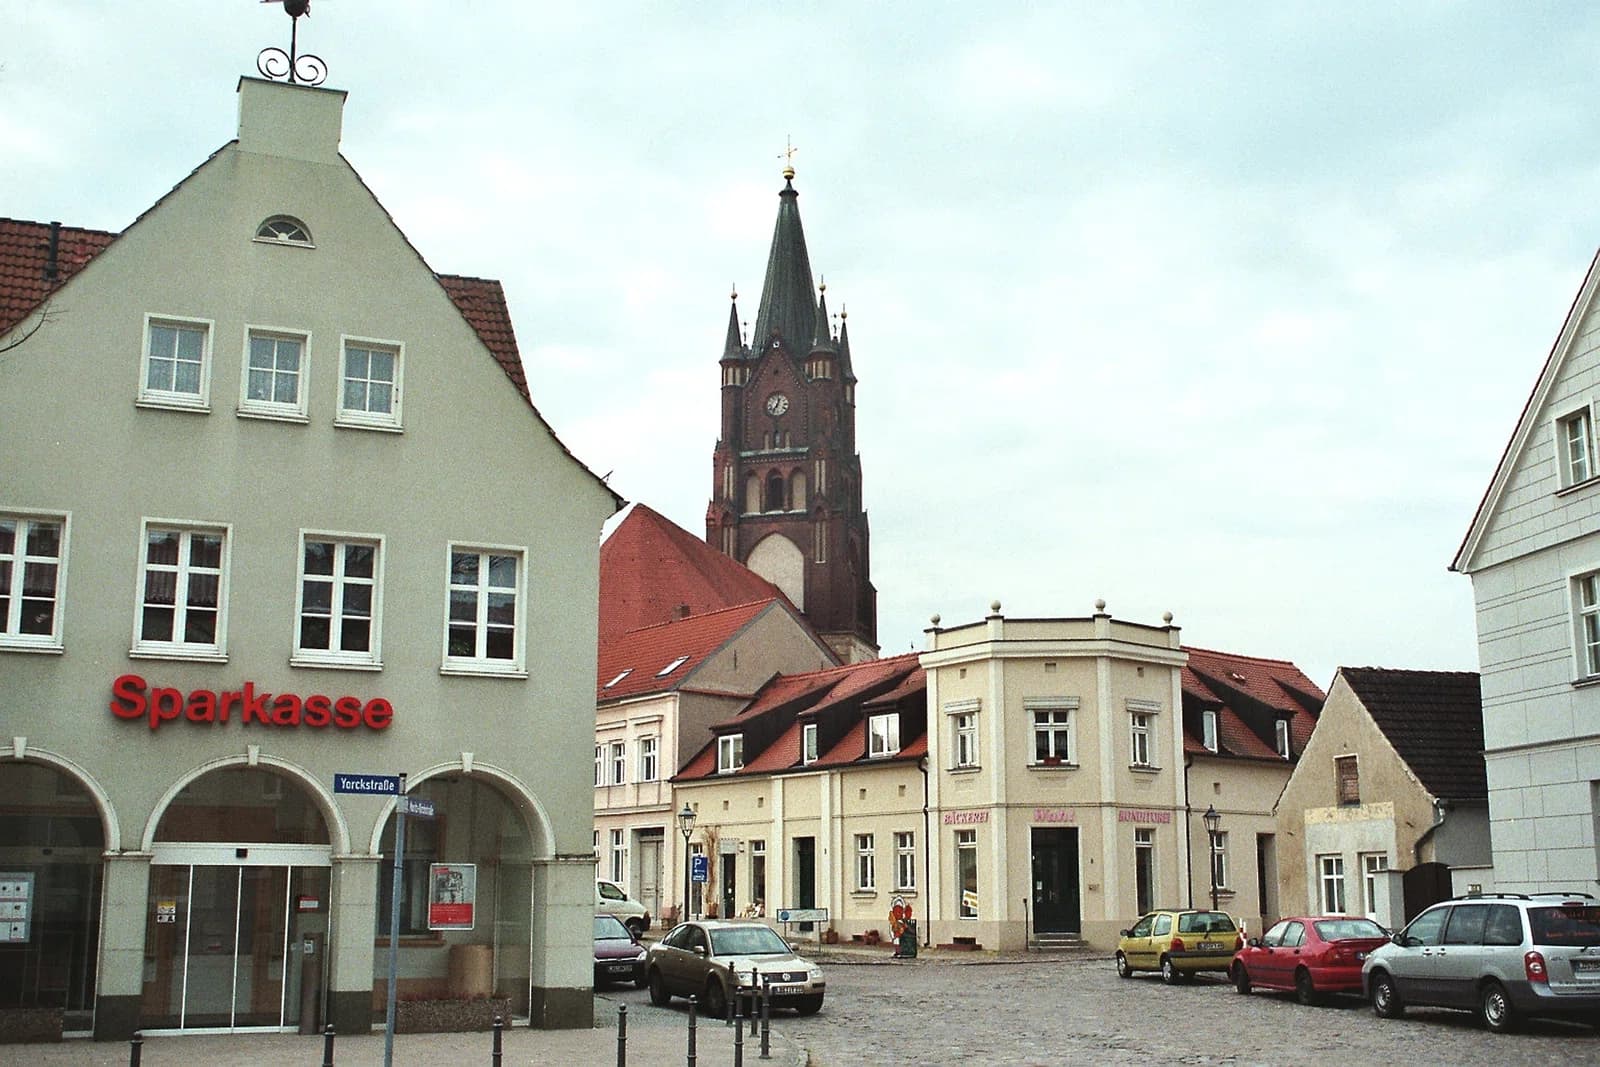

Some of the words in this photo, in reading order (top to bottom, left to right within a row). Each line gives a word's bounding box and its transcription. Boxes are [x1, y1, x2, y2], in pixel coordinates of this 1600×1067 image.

[110, 674, 394, 729] Sparkasse
[340, 777, 395, 791] Yorckstraße
[694, 858, 702, 868] P
